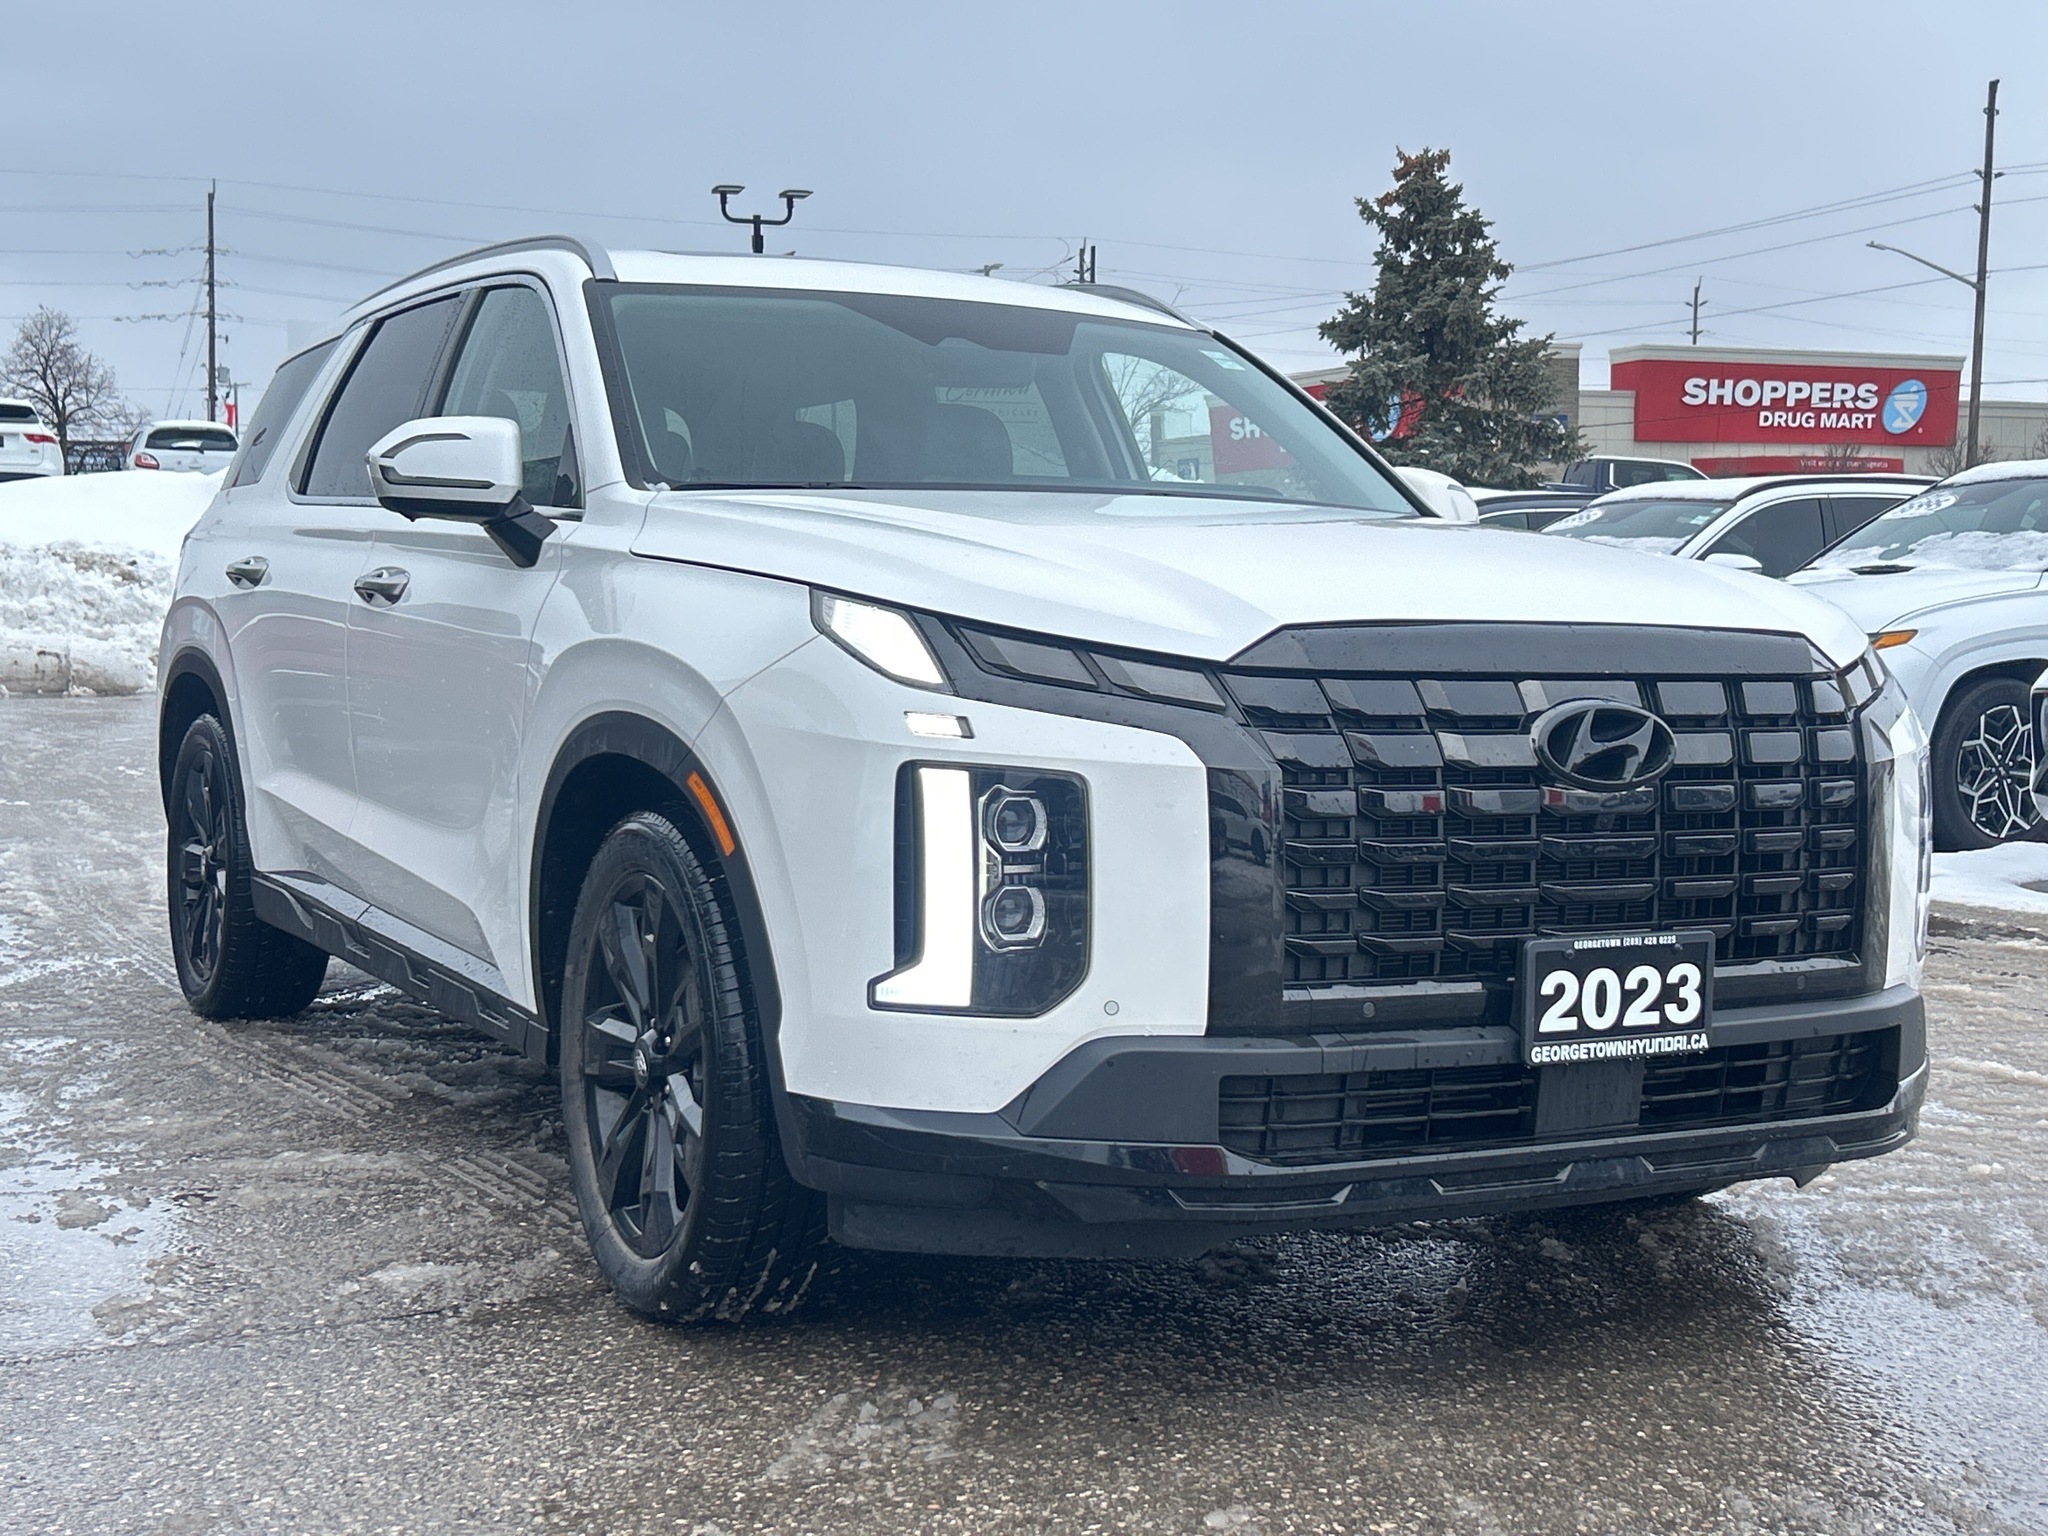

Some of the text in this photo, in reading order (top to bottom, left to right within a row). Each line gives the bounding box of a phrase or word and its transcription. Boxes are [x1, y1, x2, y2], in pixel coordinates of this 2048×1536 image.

[1682, 378, 1879, 410] SHOPPERS
[1229, 416, 1269, 440] SH
[1759, 410, 1877, 430] DRUG MART
[1573, 938, 1621, 950] GEORGETOWN
[1538, 962, 1701, 1033] 2023
[1531, 1033, 1709, 1063] GEORGETOWNHYUNDAI.CA
